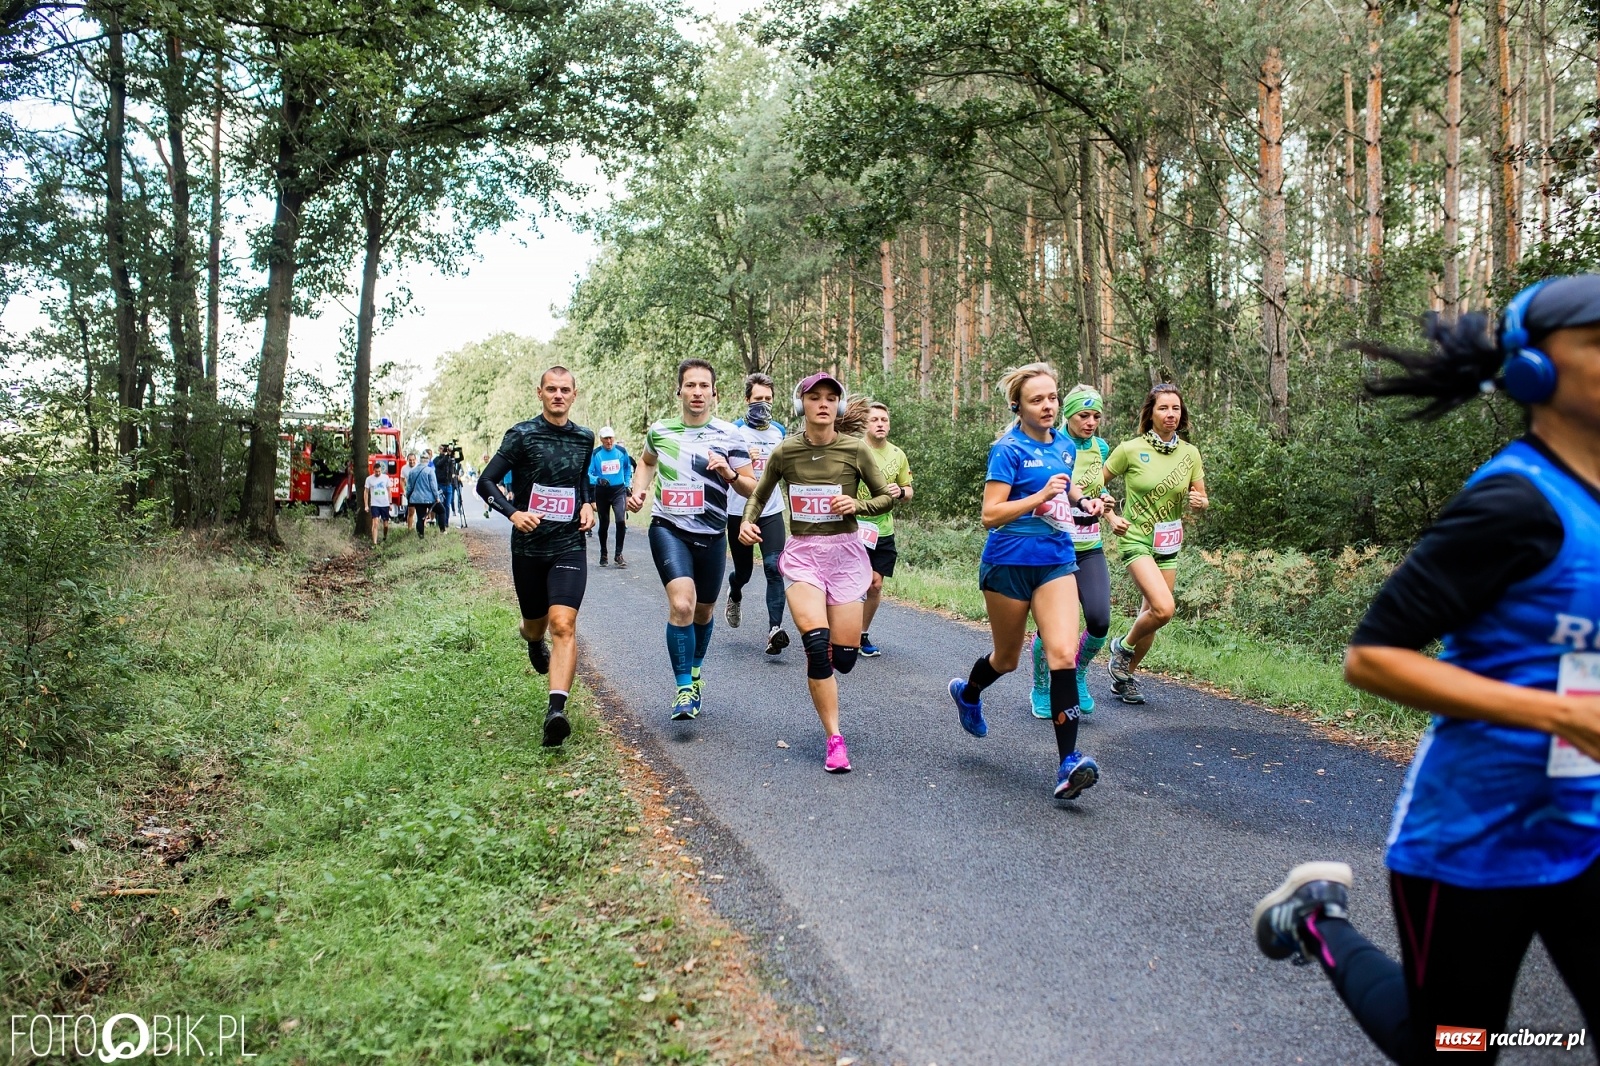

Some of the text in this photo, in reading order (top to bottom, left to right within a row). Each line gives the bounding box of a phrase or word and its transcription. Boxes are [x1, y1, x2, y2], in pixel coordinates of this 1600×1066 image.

[753, 460, 768, 470] 21
[389, 477, 400, 487] SP
[1131, 454, 1194, 521] JEJKOWICE
[536, 496, 568, 513] 230
[668, 491, 695, 506] 221
[800, 497, 831, 514] 216
[859, 528, 872, 540] 17
[1160, 531, 1180, 547] 220
[1549, 613, 1600, 649] R
